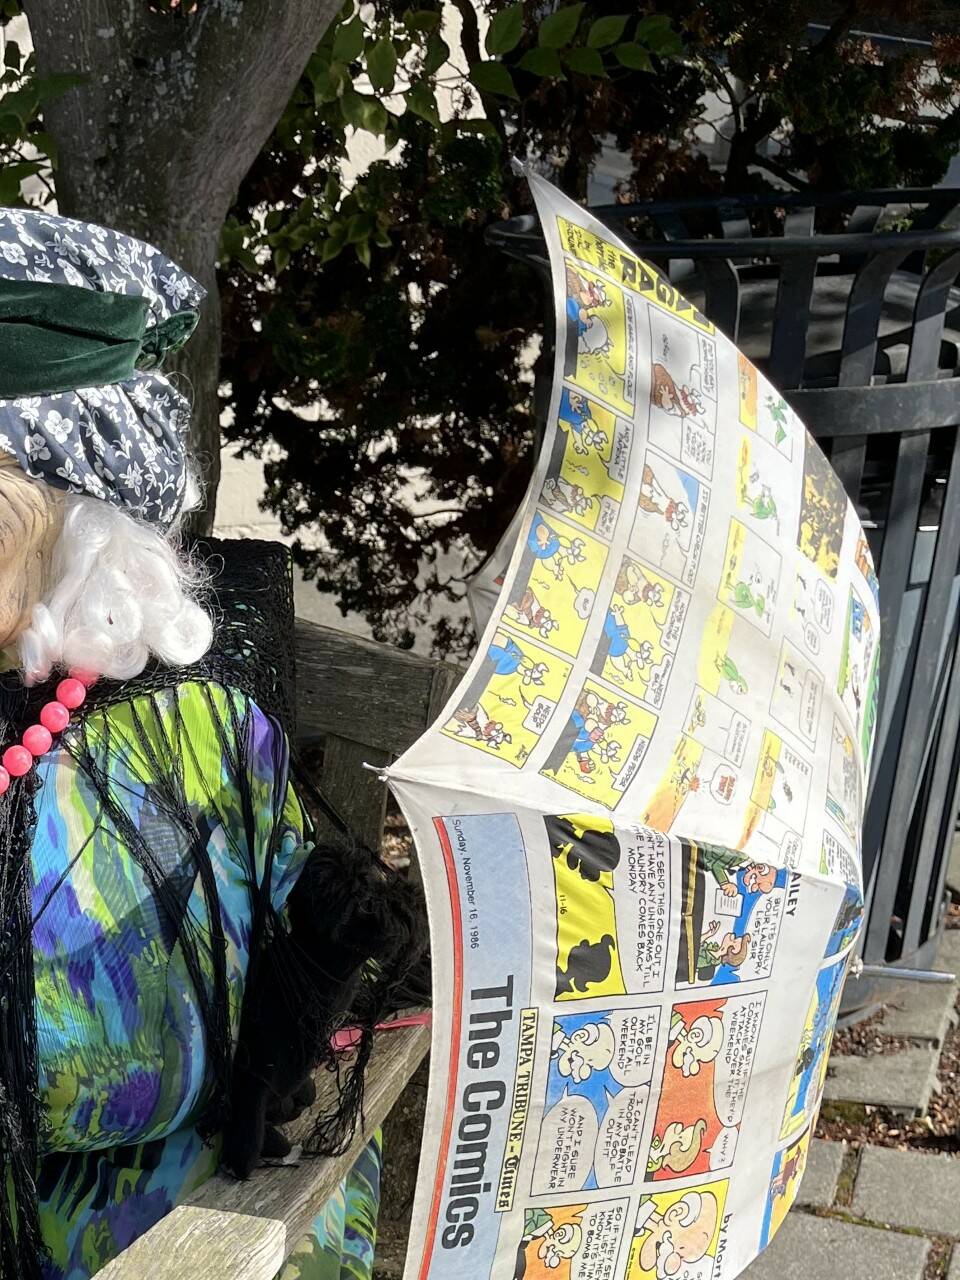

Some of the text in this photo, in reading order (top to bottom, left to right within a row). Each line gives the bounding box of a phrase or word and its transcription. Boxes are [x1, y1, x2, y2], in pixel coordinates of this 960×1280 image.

[532, 702, 543, 723] SOUP
[535, 705, 551, 729] NEEDS
[451, 819, 480, 949] Sunday, November 16, 1986
[626, 847, 639, 894] MONDAY
[636, 846, 648, 895] LAUNDRY
[656, 860, 665, 889] SEND
[559, 894, 568, 915] 11-16
[657, 893, 665, 915] THIS
[785, 870, 802, 917] AILEY
[638, 897, 648, 938] COMES
[642, 854, 657, 988] HAVE ANY UNIFORMS TILL
[656, 918, 665, 941] ONE
[753, 897, 773, 975] YOUR LAUNDRY
[761, 897, 782, 972] BUT IT'S ONLY
[635, 942, 646, 972] BACK
[749, 940, 758, 961] SIR
[519, 1012, 536, 1066] TAMPA
[616, 1017, 630, 1070] WEEKEND
[634, 1018, 647, 1068] MY GOLF
[642, 1014, 656, 1066] I'LL BE IN
[725, 1010, 740, 1064] WEEKEND
[734, 1005, 747, 1045] ATTACK
[741, 1002, 755, 1052] COMMIES
[623, 1016, 638, 1075] OUTFIT ALL
[730, 1047, 740, 1077] OVER
[735, 1054, 746, 1077] SAW
[743, 1047, 754, 1066] BUT
[741, 1068, 750, 1078] IF
[441, 974, 515, 1249] The Comics
[509, 1070, 530, 1142] TRIBUNE
[630, 1108, 642, 1140] CAN'T
[727, 1091, 739, 1123] THEY'D
[547, 1106, 569, 1190] MY UNDERWEAR
[556, 1107, 577, 1188] WON'T FIGHT IN
[568, 1114, 586, 1180] AND I SURE
[602, 1118, 616, 1160] OUTFIT
[609, 1108, 625, 1171] IN MY GOLF
[614, 1091, 636, 1183] TROOPS TO BATTLE
[718, 1133, 730, 1164] WHY?
[625, 1144, 637, 1173] LEAD
[498, 1154, 521, 1208] Times
[594, 1211, 607, 1241] KNOW
[604, 1208, 616, 1232] THAT
[611, 1224, 620, 1235] IF
[614, 1206, 623, 1221] SO
[719, 1213, 733, 1233] by
[577, 1214, 598, 1279] TO BOMB ME
[590, 1243, 601, 1261] IT'S
[605, 1236, 618, 1262] THEY
[713, 1238, 728, 1278] Mort
